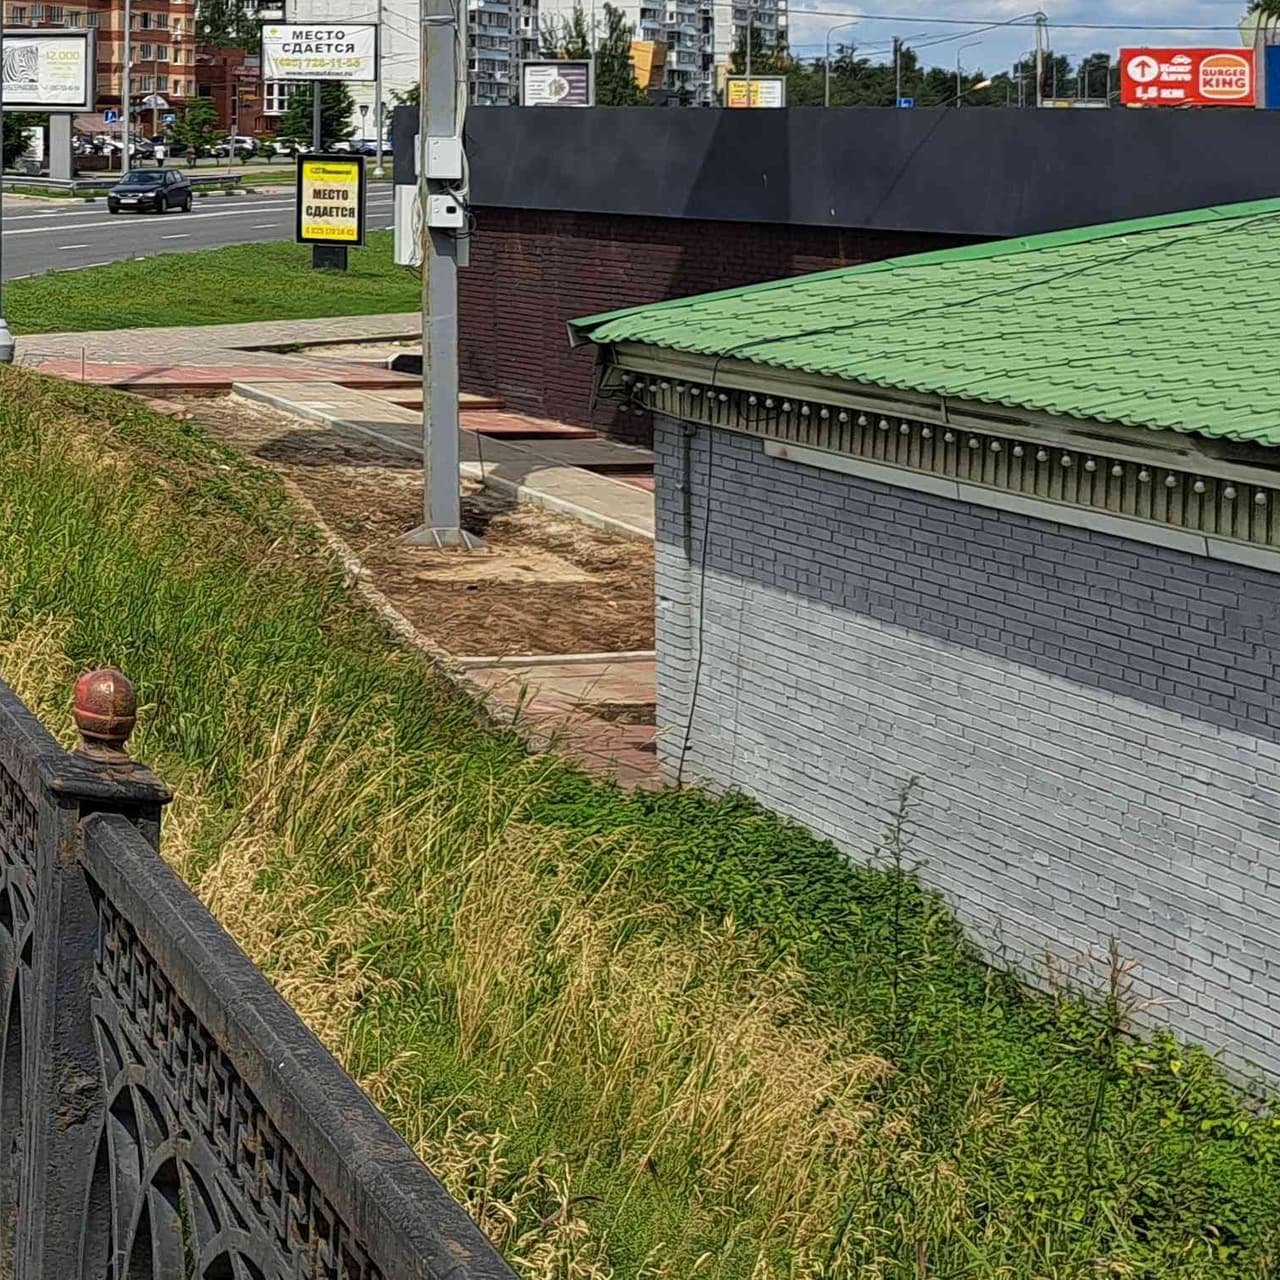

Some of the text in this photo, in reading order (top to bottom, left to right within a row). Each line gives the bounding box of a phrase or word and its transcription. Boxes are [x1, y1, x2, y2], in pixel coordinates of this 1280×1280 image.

[291, 30, 346, 41] МЕСТО
[281, 42, 355, 55] СДАЕТСЯ
[1202, 69, 1246, 77] BURGER
[1202, 78, 1246, 89] KING
[312, 188, 349, 201] МЕСТО
[305, 205, 356, 219] СДАЕТСЯ
